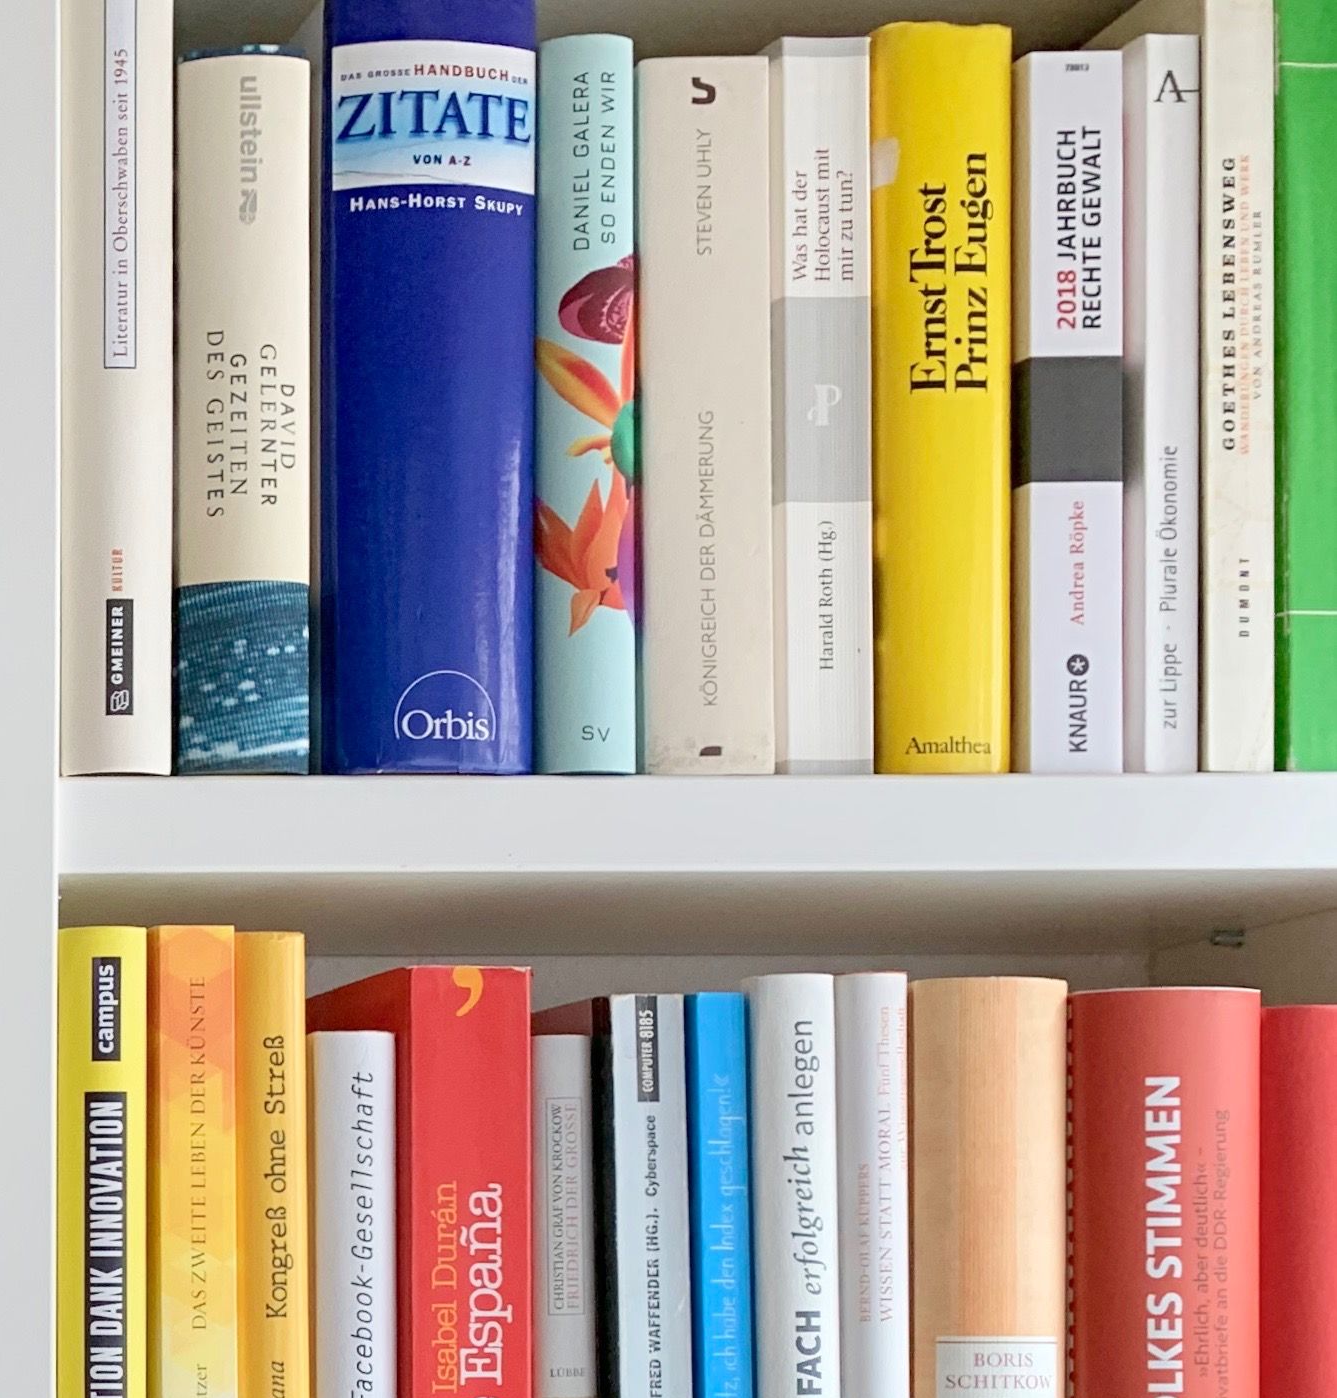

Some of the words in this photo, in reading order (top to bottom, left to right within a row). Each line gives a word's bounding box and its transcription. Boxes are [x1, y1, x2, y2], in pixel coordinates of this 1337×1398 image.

[114, 48, 128, 86] 1945
[602, 70, 614, 115] WIR
[336, 90, 530, 144] ZITATE
[573, 72, 589, 156] GALERA
[112, 128, 128, 252] Oberschwaben
[575, 160, 590, 251] DANIEL
[602, 120, 615, 206] ENDEN
[1056, 129, 1076, 262] JAHRBUCH
[1082, 127, 1101, 224] GEWALT
[602, 213, 616, 245] SO
[909, 182, 947, 283] Trost
[954, 151, 994, 276] Eugen
[113, 259, 128, 278] in
[1056, 269, 1076, 330] 2018
[1082, 231, 1101, 329] RECHTE
[112, 281, 128, 359] Literatur
[909, 283, 947, 395] Ernst
[955, 286, 988, 393] Prinz
[110, 605, 124, 687] GMEINER
[402, 709, 490, 743] Orbis
[1069, 678, 1087, 752] KNAUR
[99, 965, 118, 1053] campus
[789, 1018, 821, 1135] anlegen
[89, 1100, 124, 1258] INNOVATION
[785, 1145, 825, 1296] erfolgreich
[1145, 1077, 1182, 1278] STIMMEN
[90, 1267, 124, 1338] DANK
[460, 1183, 512, 1385] España
